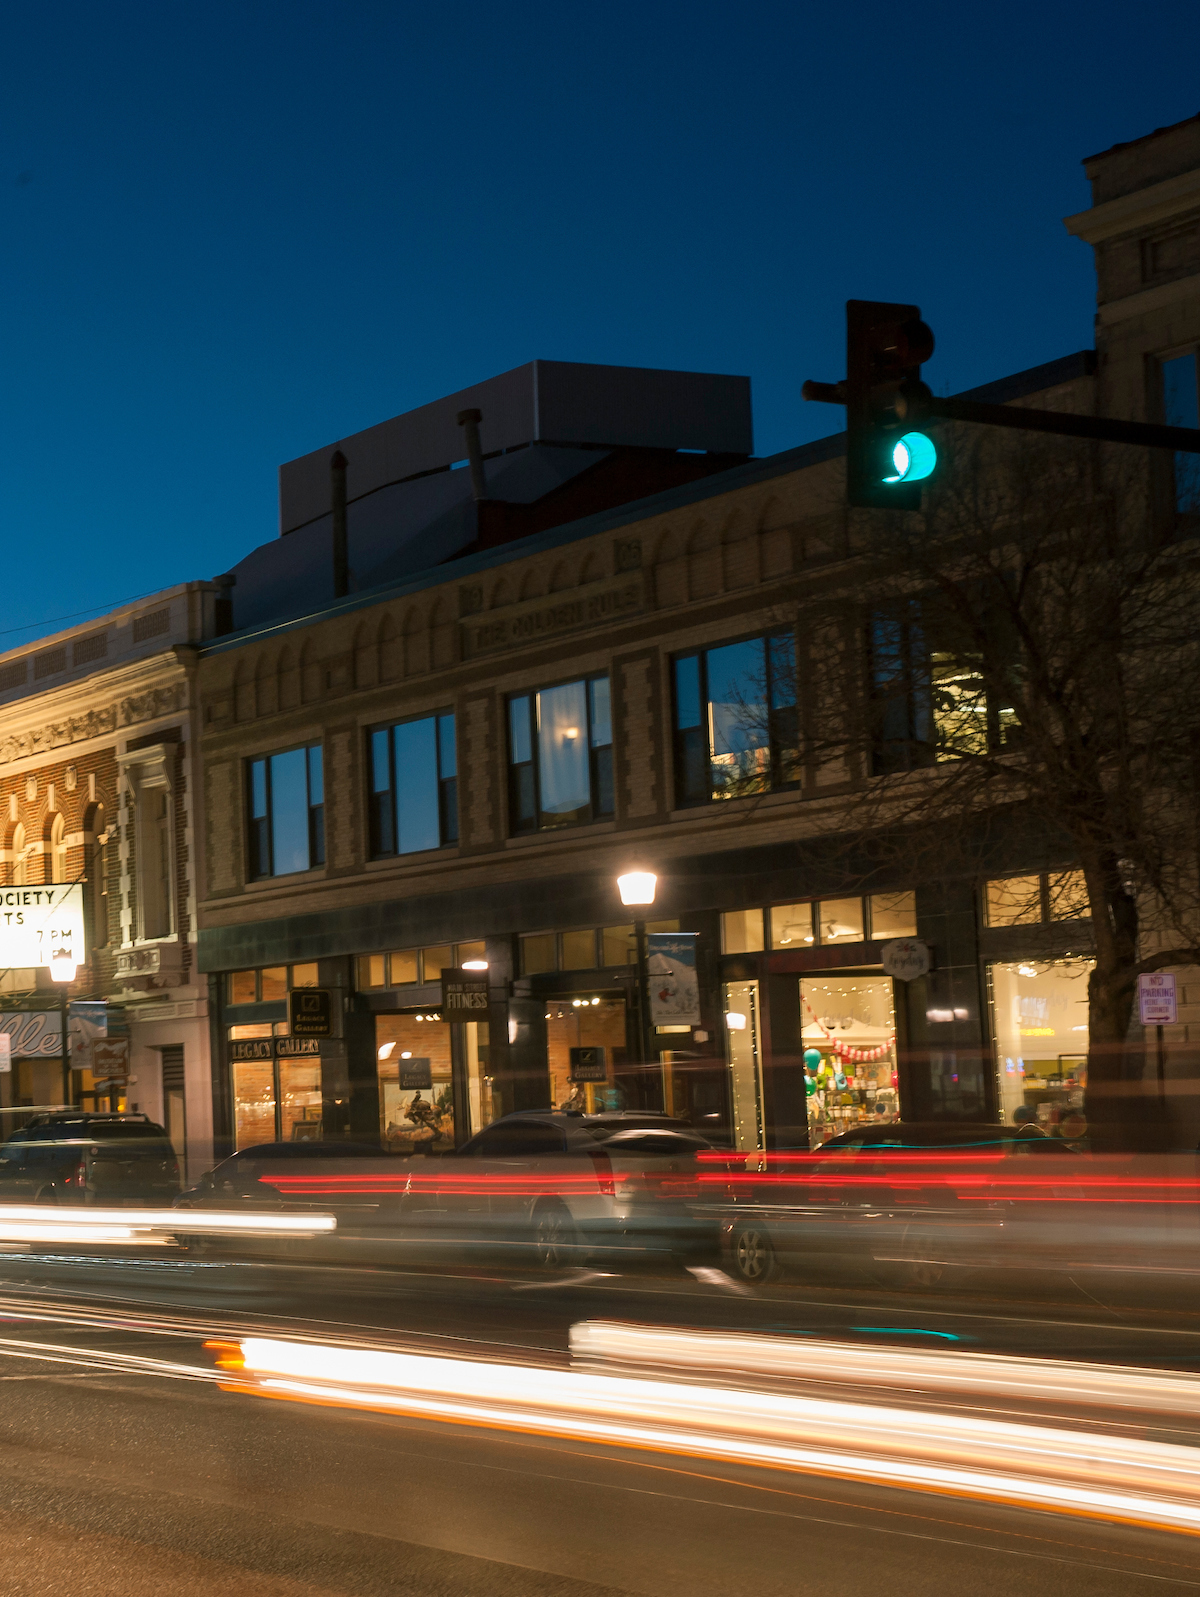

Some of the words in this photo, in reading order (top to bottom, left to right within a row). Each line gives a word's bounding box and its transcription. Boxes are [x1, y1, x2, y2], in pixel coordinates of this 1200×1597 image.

[35, 930, 44, 943] 7
[50, 929, 73, 943] PM
[1150, 976, 1164, 986] NO
[1141, 988, 1174, 998] PARKING
[446, 992, 489, 1009] FITNESS
[295, 1024, 329, 1032] GALLERY
[232, 1042, 272, 1060] LEGACY
[276, 1039, 320, 1055] GALLERY
